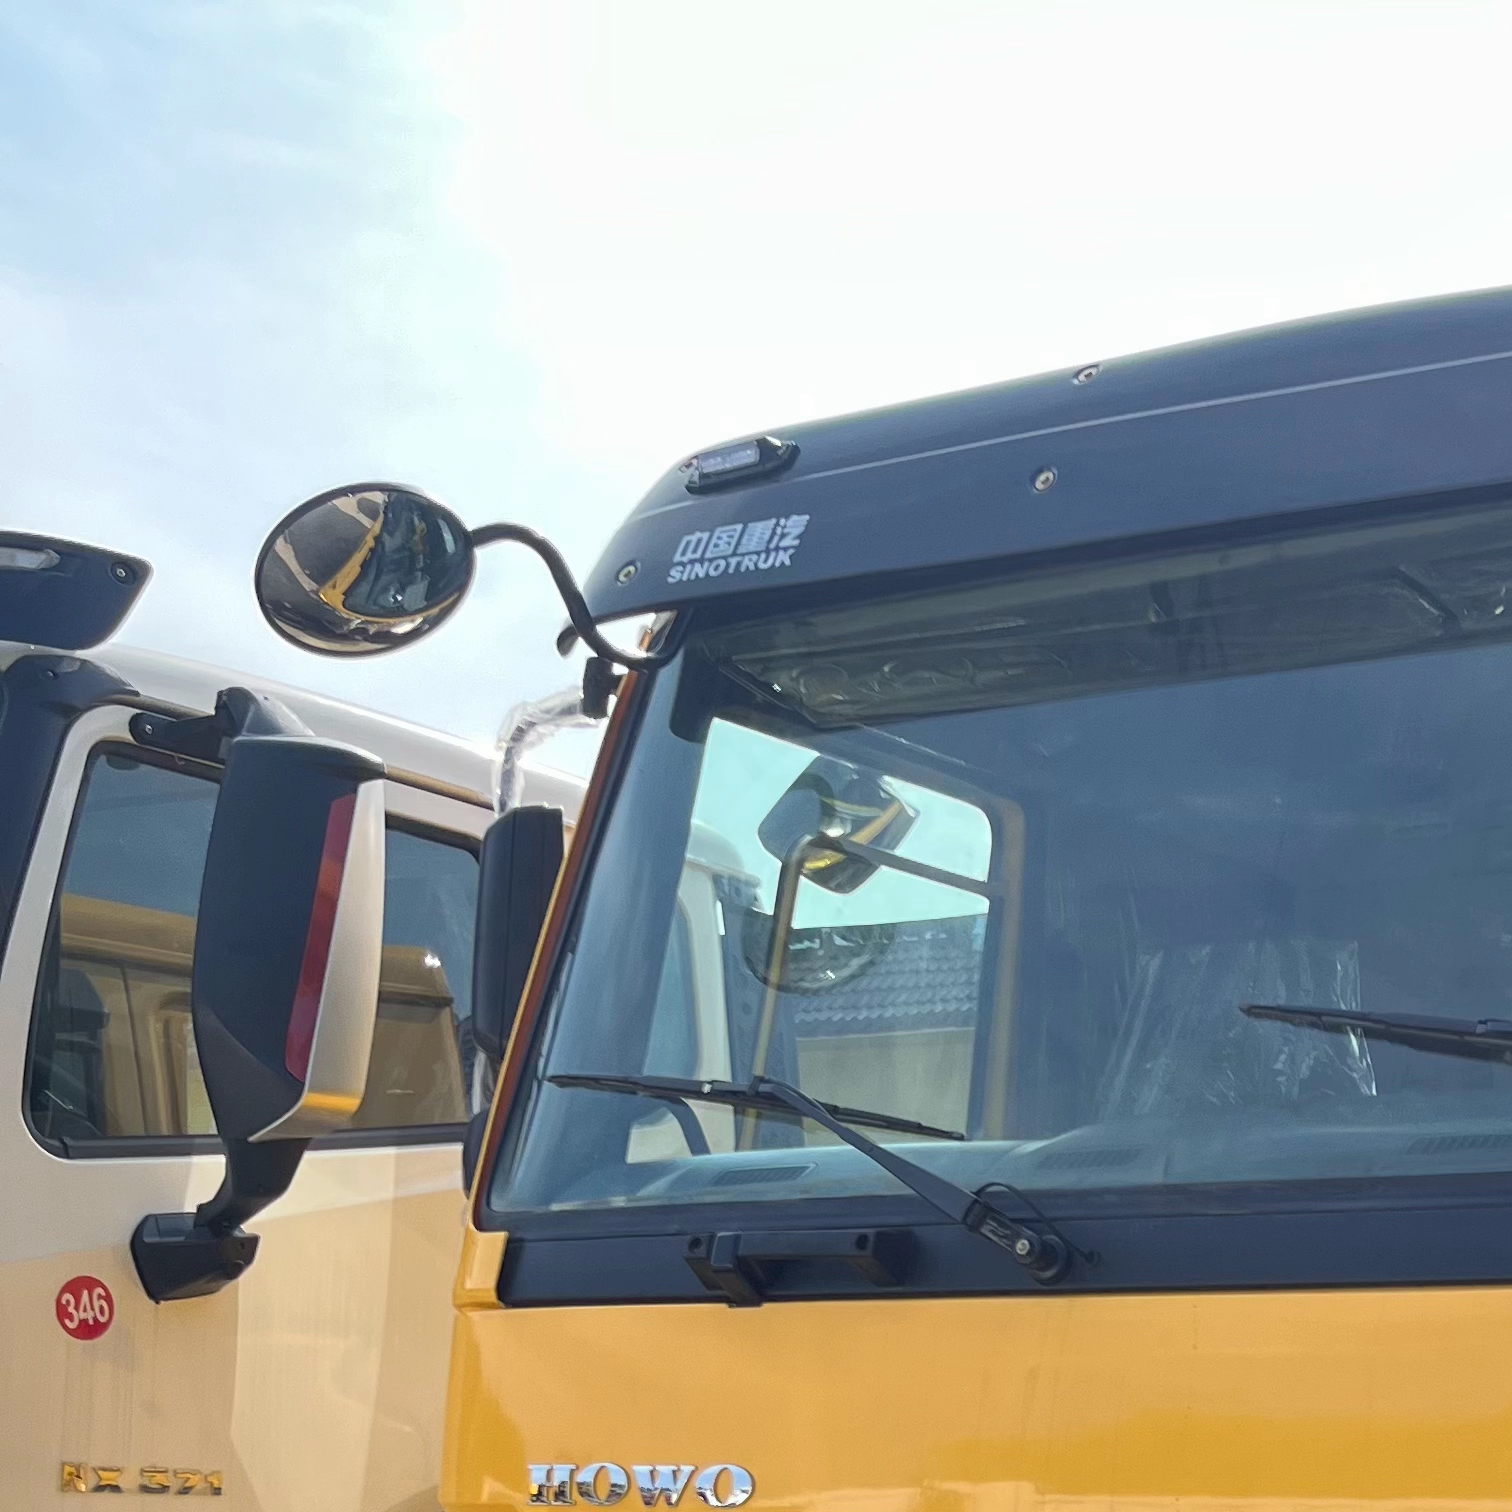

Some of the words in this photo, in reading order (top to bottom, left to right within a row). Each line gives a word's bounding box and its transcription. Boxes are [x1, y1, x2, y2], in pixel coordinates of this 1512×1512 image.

[673, 514, 810, 563] 中国重汽
[666, 548, 796, 584] SINOTRUK
[61, 1287, 110, 1329] 346
[527, 1463, 755, 1508] HOWO
